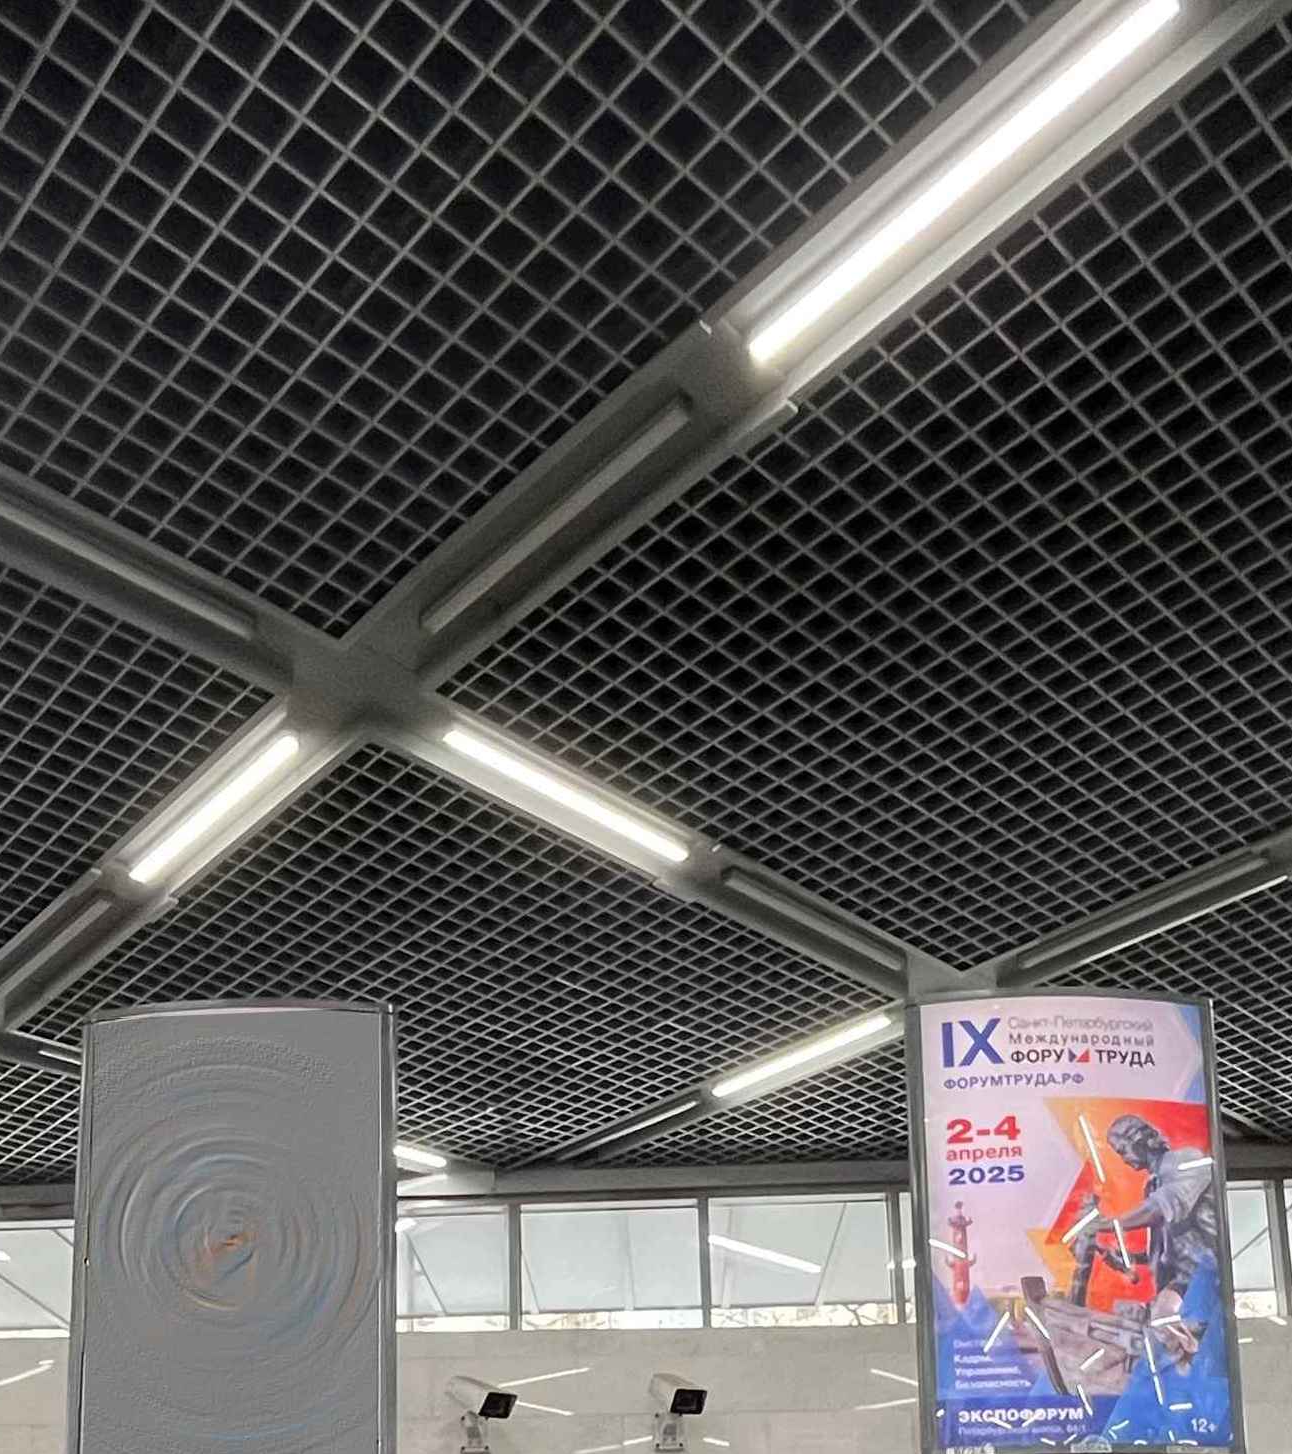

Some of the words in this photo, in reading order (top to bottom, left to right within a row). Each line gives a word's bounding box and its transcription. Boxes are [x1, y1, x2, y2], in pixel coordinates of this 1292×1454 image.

[941, 1018, 1005, 1068] IX
[1008, 1033, 1155, 1047] Международный
[1096, 1049, 1156, 1067] ТРУДА
[943, 1072, 1085, 1090] ФОРУМТРУДА.РФ
[946, 1115, 1022, 1144] 2-4
[946, 1145, 1023, 1163] апреля
[948, 1164, 1025, 1185] 2025
[958, 1407, 1085, 1424] ЭКСПОФОРУМ
[1190, 1417, 1218, 1433] 12+
